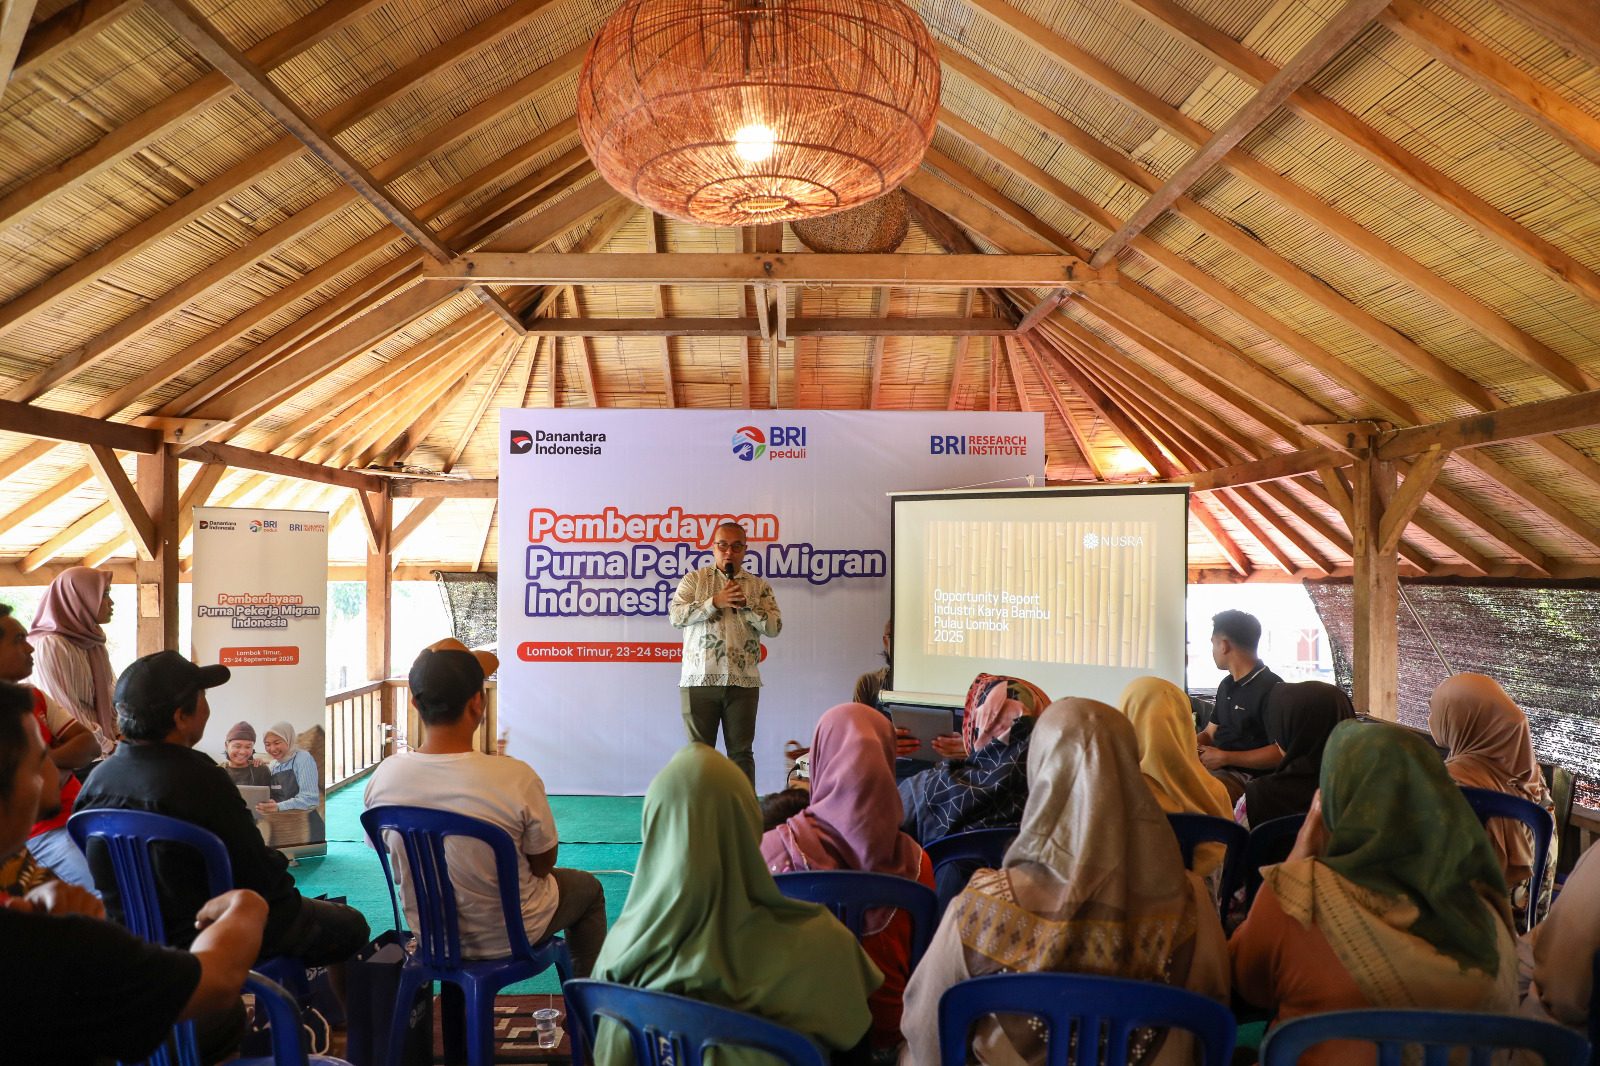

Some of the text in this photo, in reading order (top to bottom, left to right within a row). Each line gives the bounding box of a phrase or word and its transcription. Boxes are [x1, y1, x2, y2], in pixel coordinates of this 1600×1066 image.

[535, 430, 606, 442] Danantara
[769, 426, 806, 447] BRI
[968, 435, 1027, 446] RESEARCH
[535, 443, 602, 455] Indonesia
[930, 435, 966, 455] BRI
[968, 446, 1027, 456] INSTITUTE
[769, 448, 806, 461] peduli
[263, 520, 278, 528] BRI
[289, 523, 303, 532] BRI
[529, 507, 778, 549] Pemberdayan
[1101, 535, 1144, 547] NUSRA
[526, 544, 886, 585] Purna Pekea Migran
[218, 593, 303, 606] Pemberdayaan
[525, 580, 676, 617] Indonesi
[934, 588, 1040, 606] Opportunity Report
[198, 604, 320, 618] Purna Pekerja Migran
[934, 602, 1050, 620] Industri Karya Bambu
[232, 616, 288, 628] Indonesia
[934, 615, 1010, 632] Pulau Lombok
[934, 629, 964, 643] 2025
[526, 646, 573, 657] Lombok
[576, 646, 613, 658] Timur,
[616, 646, 652, 657] 23-24
